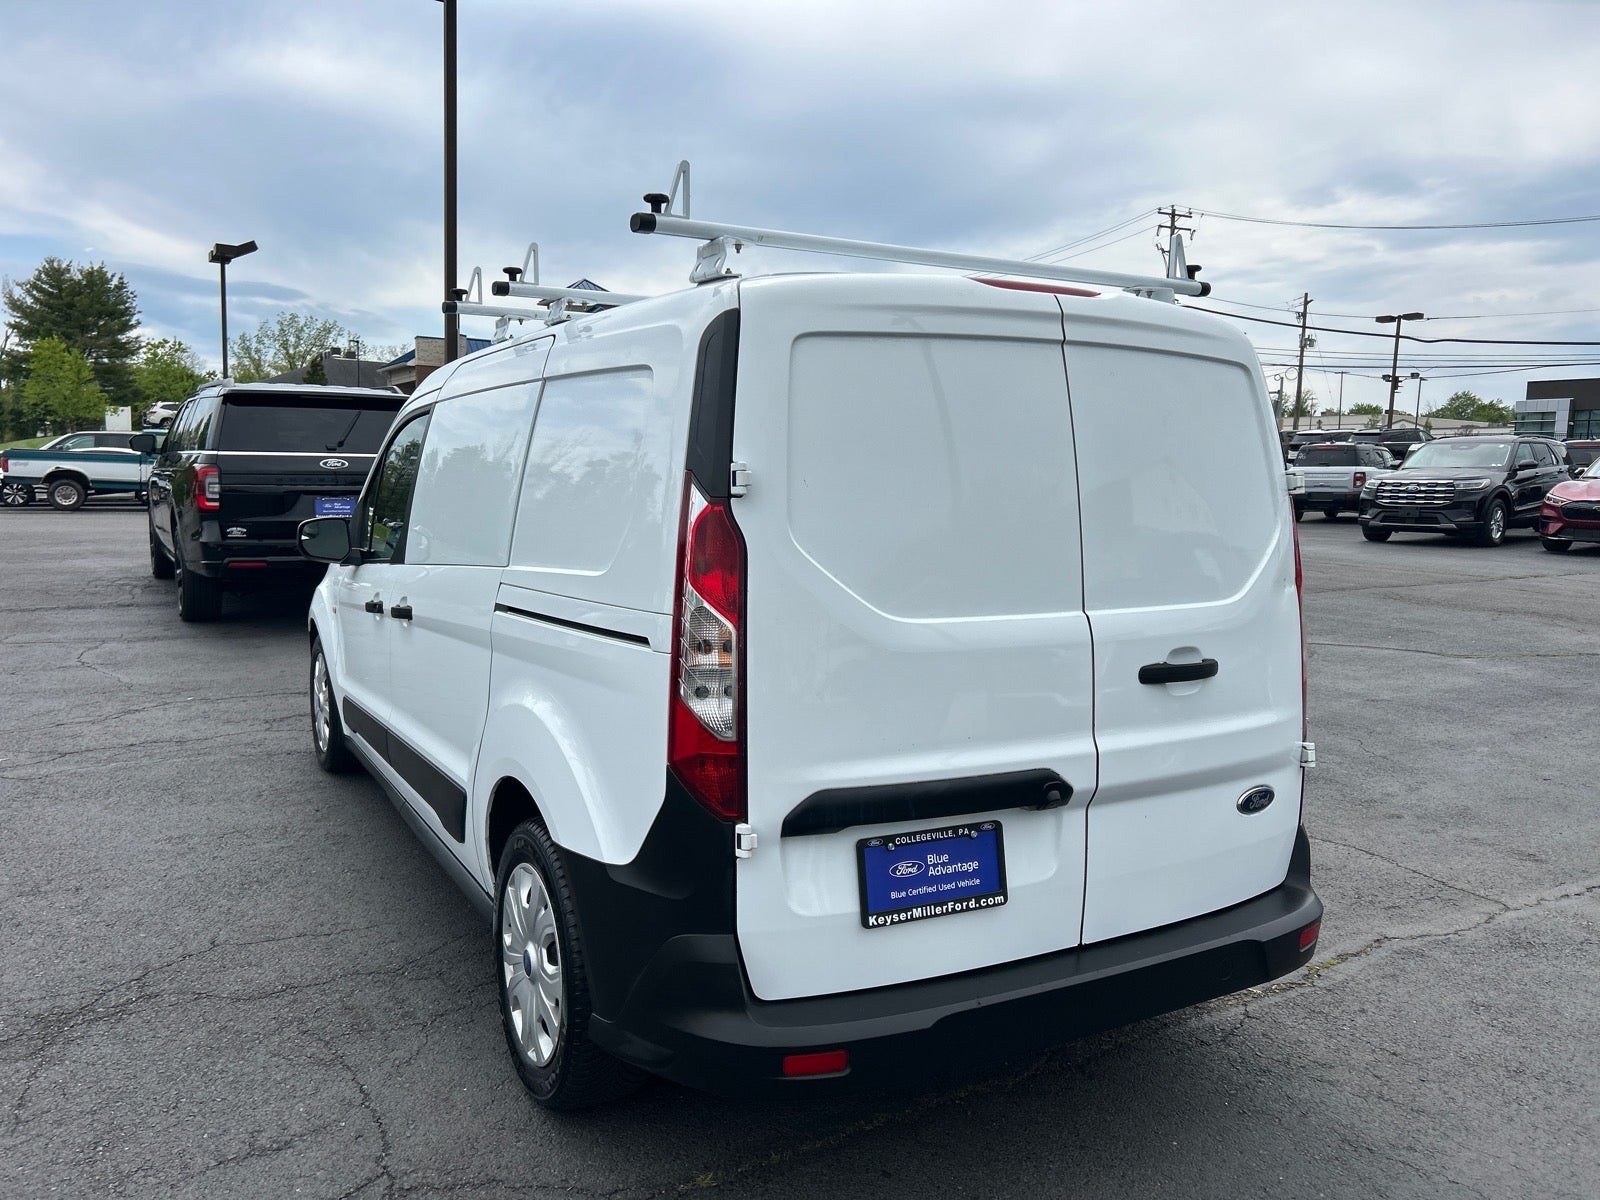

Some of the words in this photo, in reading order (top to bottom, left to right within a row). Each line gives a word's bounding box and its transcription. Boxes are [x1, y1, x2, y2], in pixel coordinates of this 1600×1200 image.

[895, 830, 956, 844] COLLEGEVILLE,
[958, 827, 970, 836] PA
[927, 853, 949, 865] Blue
[928, 861, 979, 877] Advantage
[890, 891, 907, 899] Blue
[908, 885, 937, 897] Certified
[938, 882, 956, 892] Used
[957, 877, 981, 888] Vehicle
[868, 895, 1005, 926] KeyserMillerFord.com
